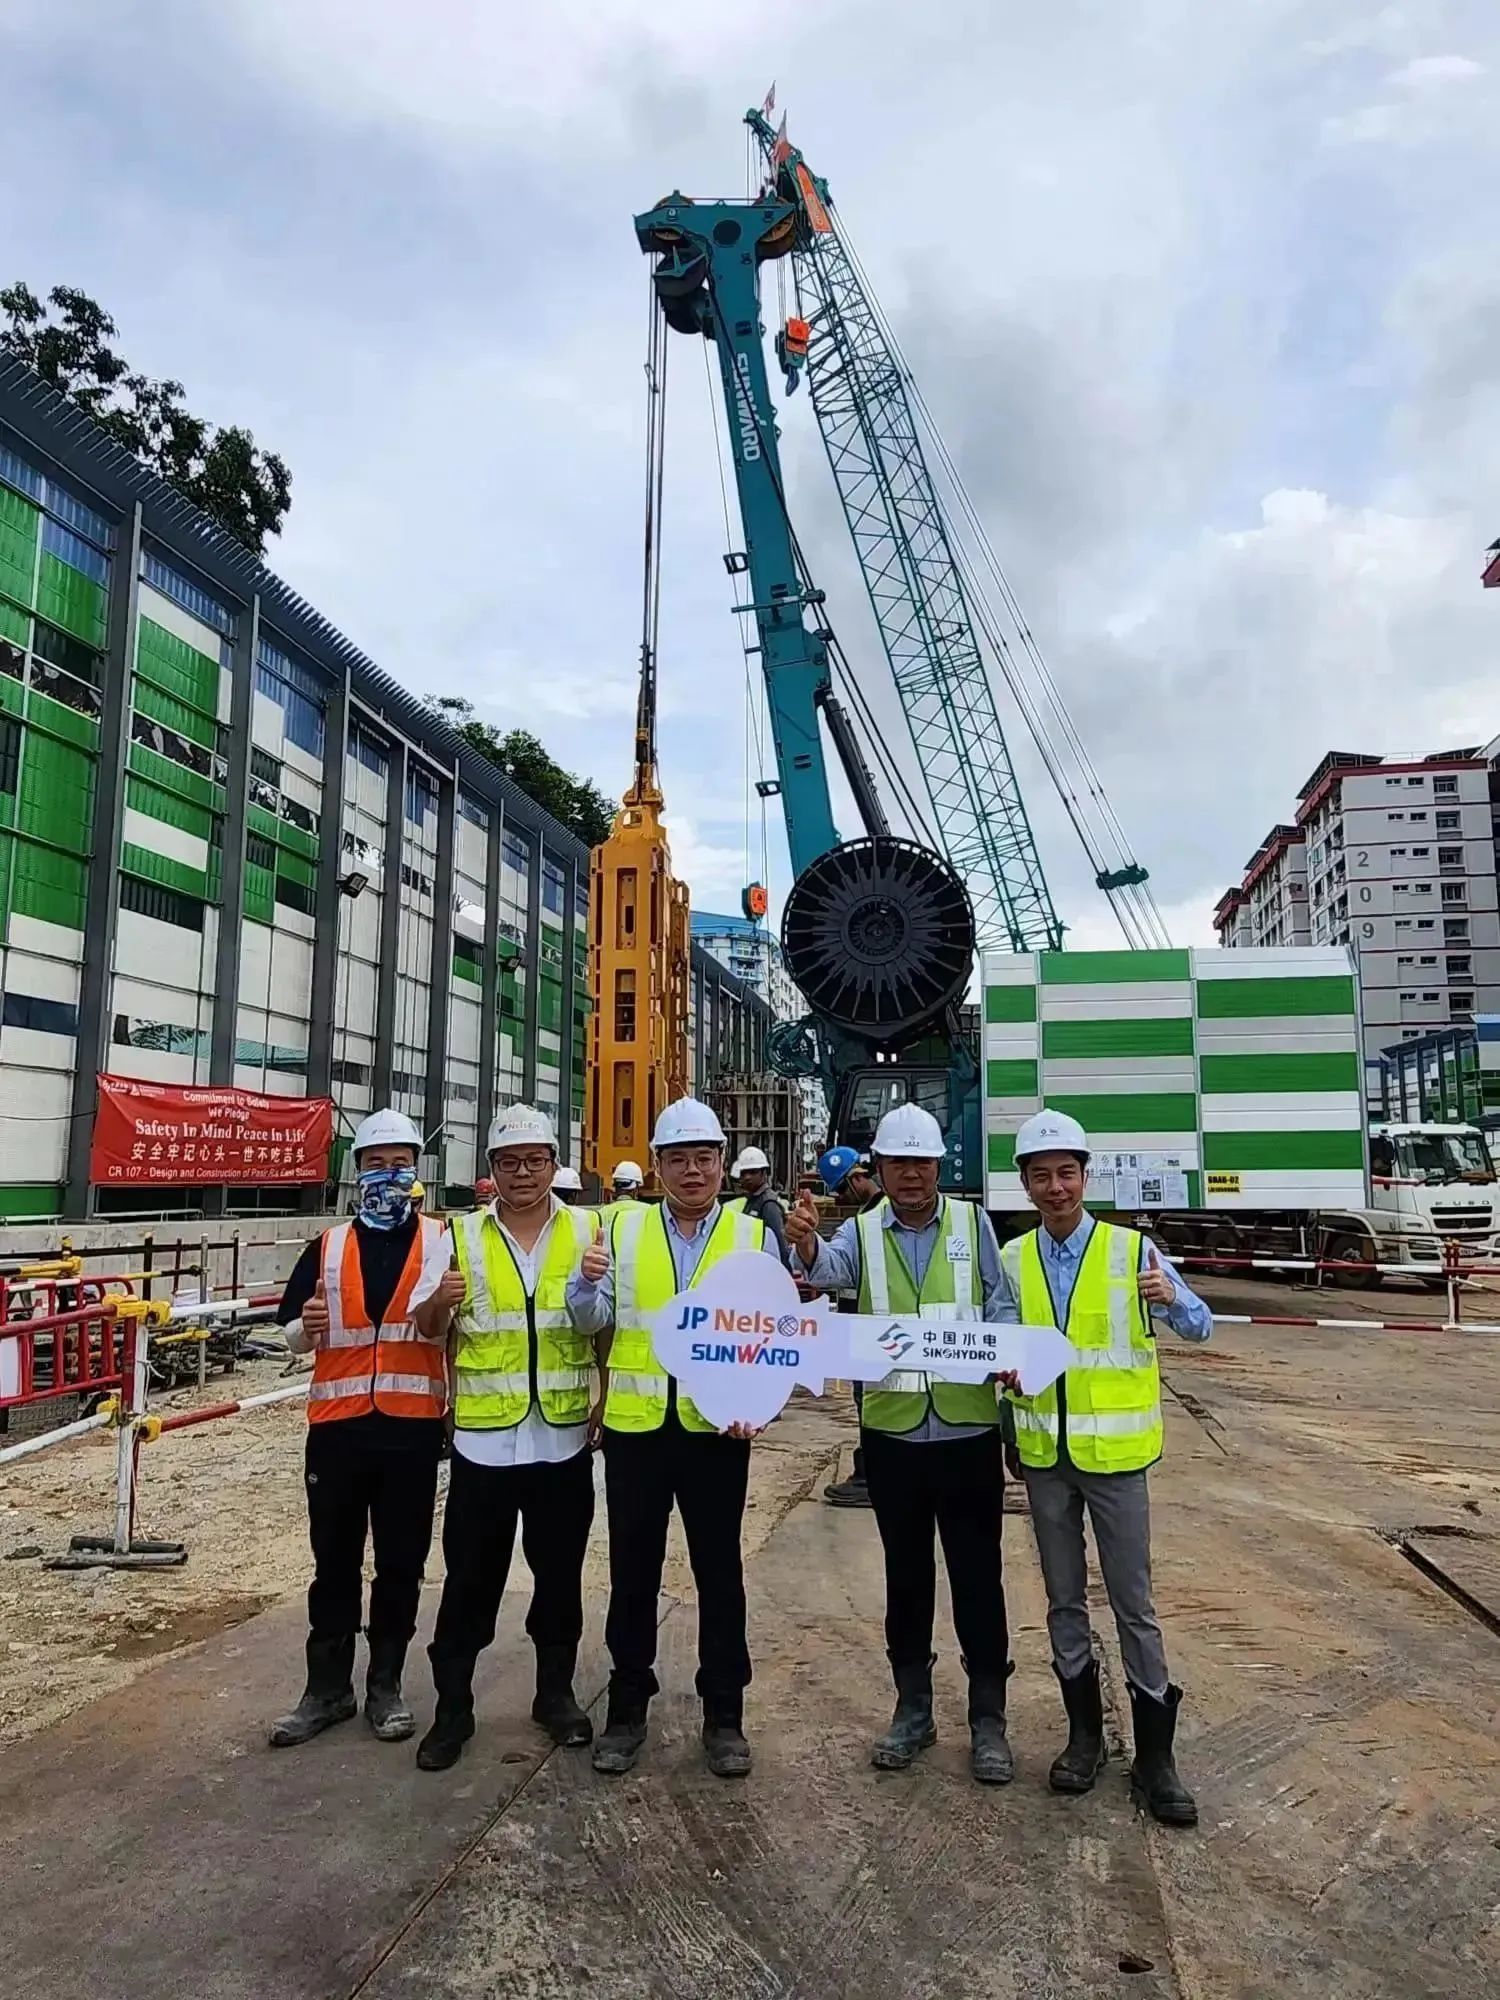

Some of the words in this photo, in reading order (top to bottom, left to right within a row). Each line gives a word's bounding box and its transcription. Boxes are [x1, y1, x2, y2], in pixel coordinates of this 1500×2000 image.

[183, 1090, 235, 1105] Commitment
[237, 1095, 246, 1106] to
[208, 1106, 222, 1118] We
[225, 1108, 250, 1121] Pledge
[135, 1119, 178, 1141] Safety
[182, 1122, 197, 1137] In
[200, 1122, 232, 1139] Mind
[236, 1125, 268, 1140] Peace
[271, 1128, 282, 1141] In
[285, 1128, 306, 1142] Life
[131, 1140, 305, 1163] 安全牢记心头一世不吃苦头
[108, 1166, 122, 1177] CR
[126, 1167, 142, 1177] 107
[149, 1166, 178, 1180] Design
[180, 1168, 194, 1178] and
[196, 1168, 241, 1178] Construction
[242, 1168, 250, 1178] of
[677, 1306, 708, 1330] JP
[714, 1309, 818, 1337] Nelson
[923, 1330, 997, 1348] 中国水电
[691, 1338, 800, 1367] SUNWARD
[922, 1347, 997, 1361] SINOHYDRO
